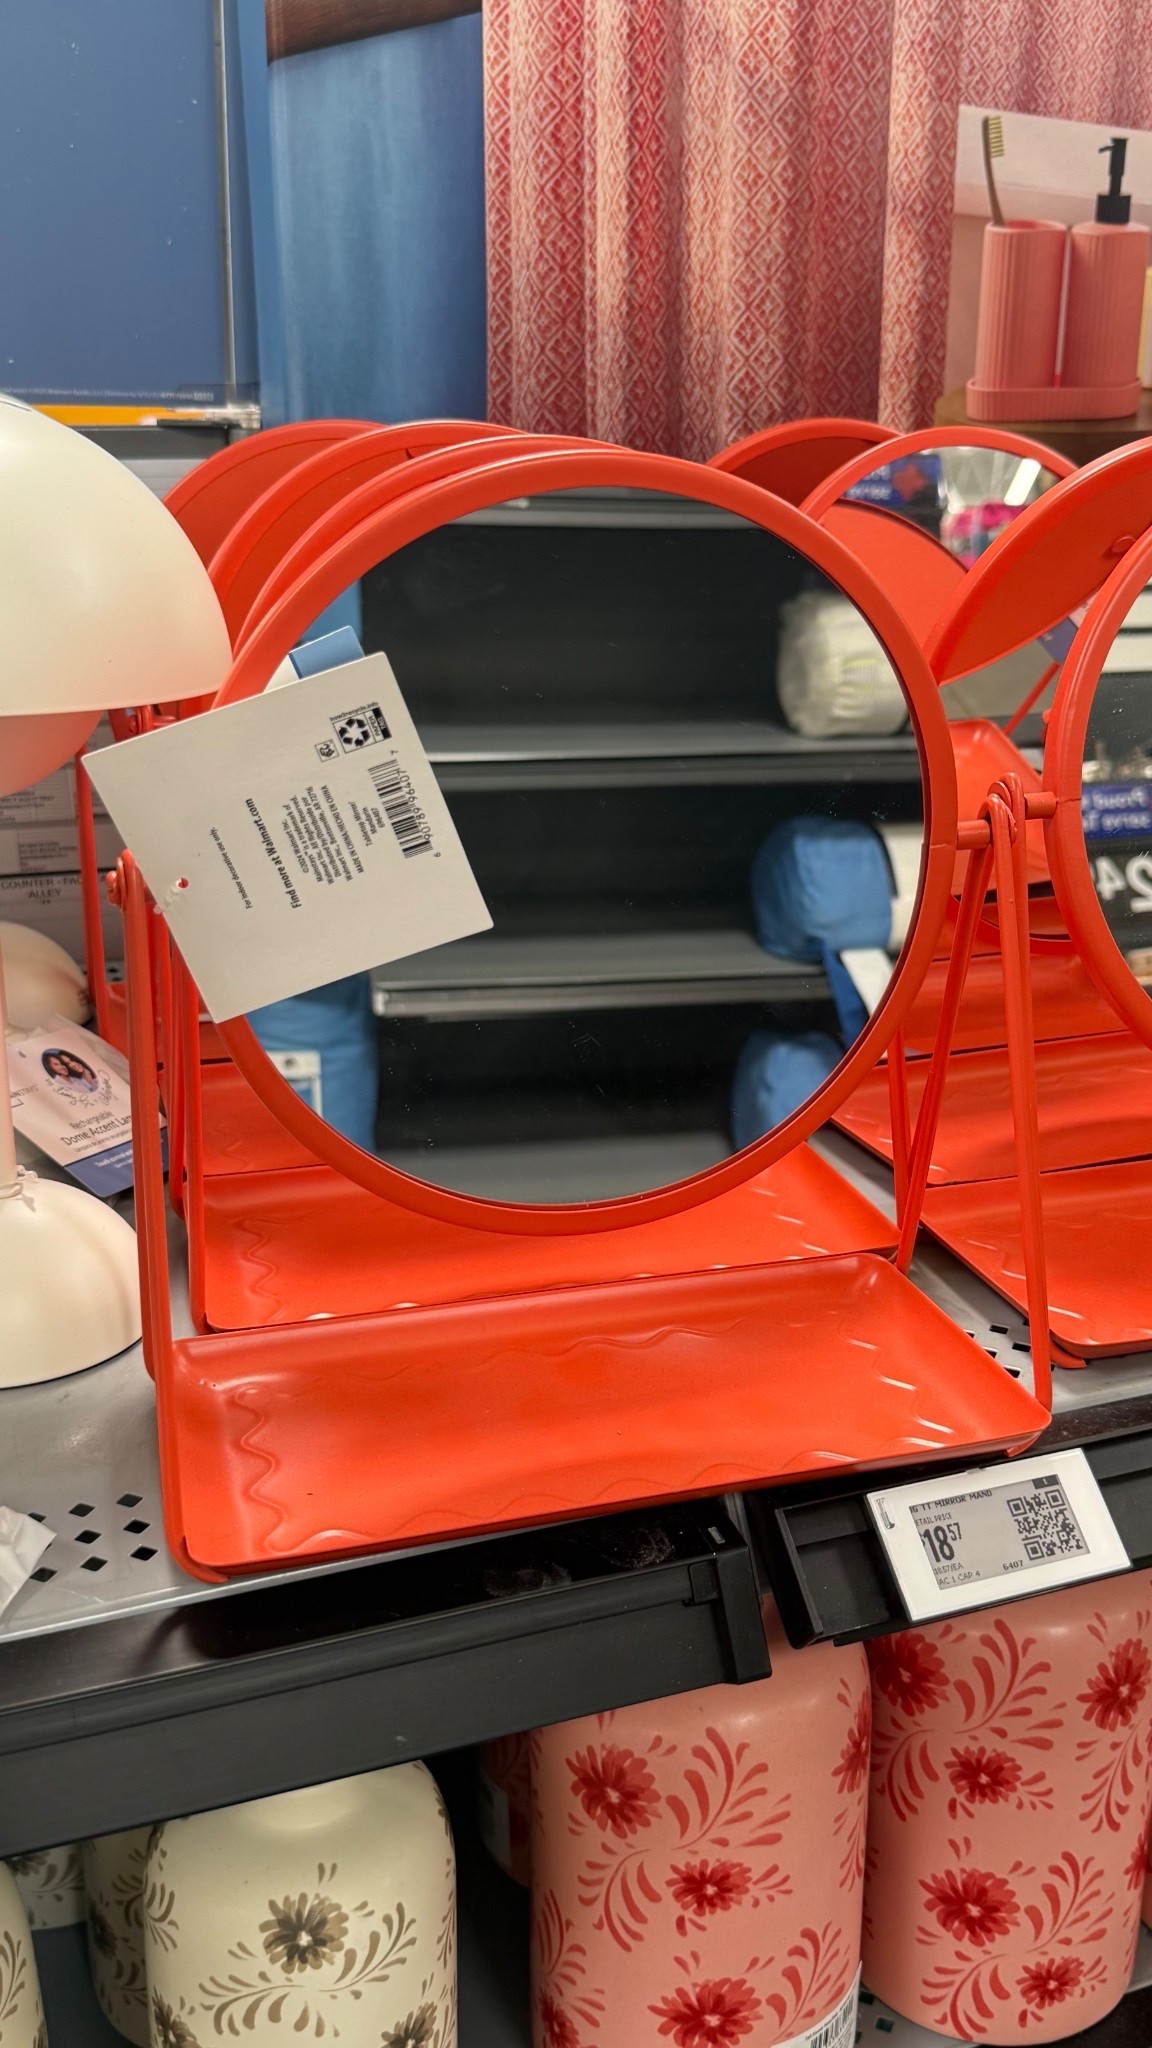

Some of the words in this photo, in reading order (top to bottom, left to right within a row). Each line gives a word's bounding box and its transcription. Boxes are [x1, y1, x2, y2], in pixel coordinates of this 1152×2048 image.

[369, 716, 381, 736] PAPER
[321, 785, 334, 803] CHINA
[397, 768, 418, 802] 96407
[290, 795, 307, 823] Reserved.
[329, 804, 337, 812] EN
[245, 798, 277, 855] Walmart.com
[282, 819, 290, 830] Inc.
[287, 811, 305, 840] trademark
[362, 807, 377, 834] Mandarin
[412, 807, 434, 840] 90789
[210, 827, 220, 841] only.
[286, 830, 301, 854] Walmart
[304, 823, 314, 841] Rights
[358, 821, 372, 846] Tabletop
[217, 842, 225, 851] use
[222, 852, 239, 880] decorative
[271, 856, 282, 865] at
[323, 846, 342, 877] Distributed
[338, 857, 353, 881] Walmart
[352, 857, 364, 873] MADE
[277, 866, 293, 888] more
[320, 860, 334, 884] Walmart
[28, 889, 62, 898] ALLEY
[236, 881, 248, 899] indoor
[285, 889, 302, 908] Find
[244, 900, 253, 908] For
[60, 1130, 90, 1146] Dome
[90, 1121, 118, 1138] Accent
[935, 1495, 967, 1509] MIRROR
[969, 1489, 993, 1501] MAND
[935, 1512, 952, 1524] PRICE
[1003, 1560, 1024, 1570] 6407
